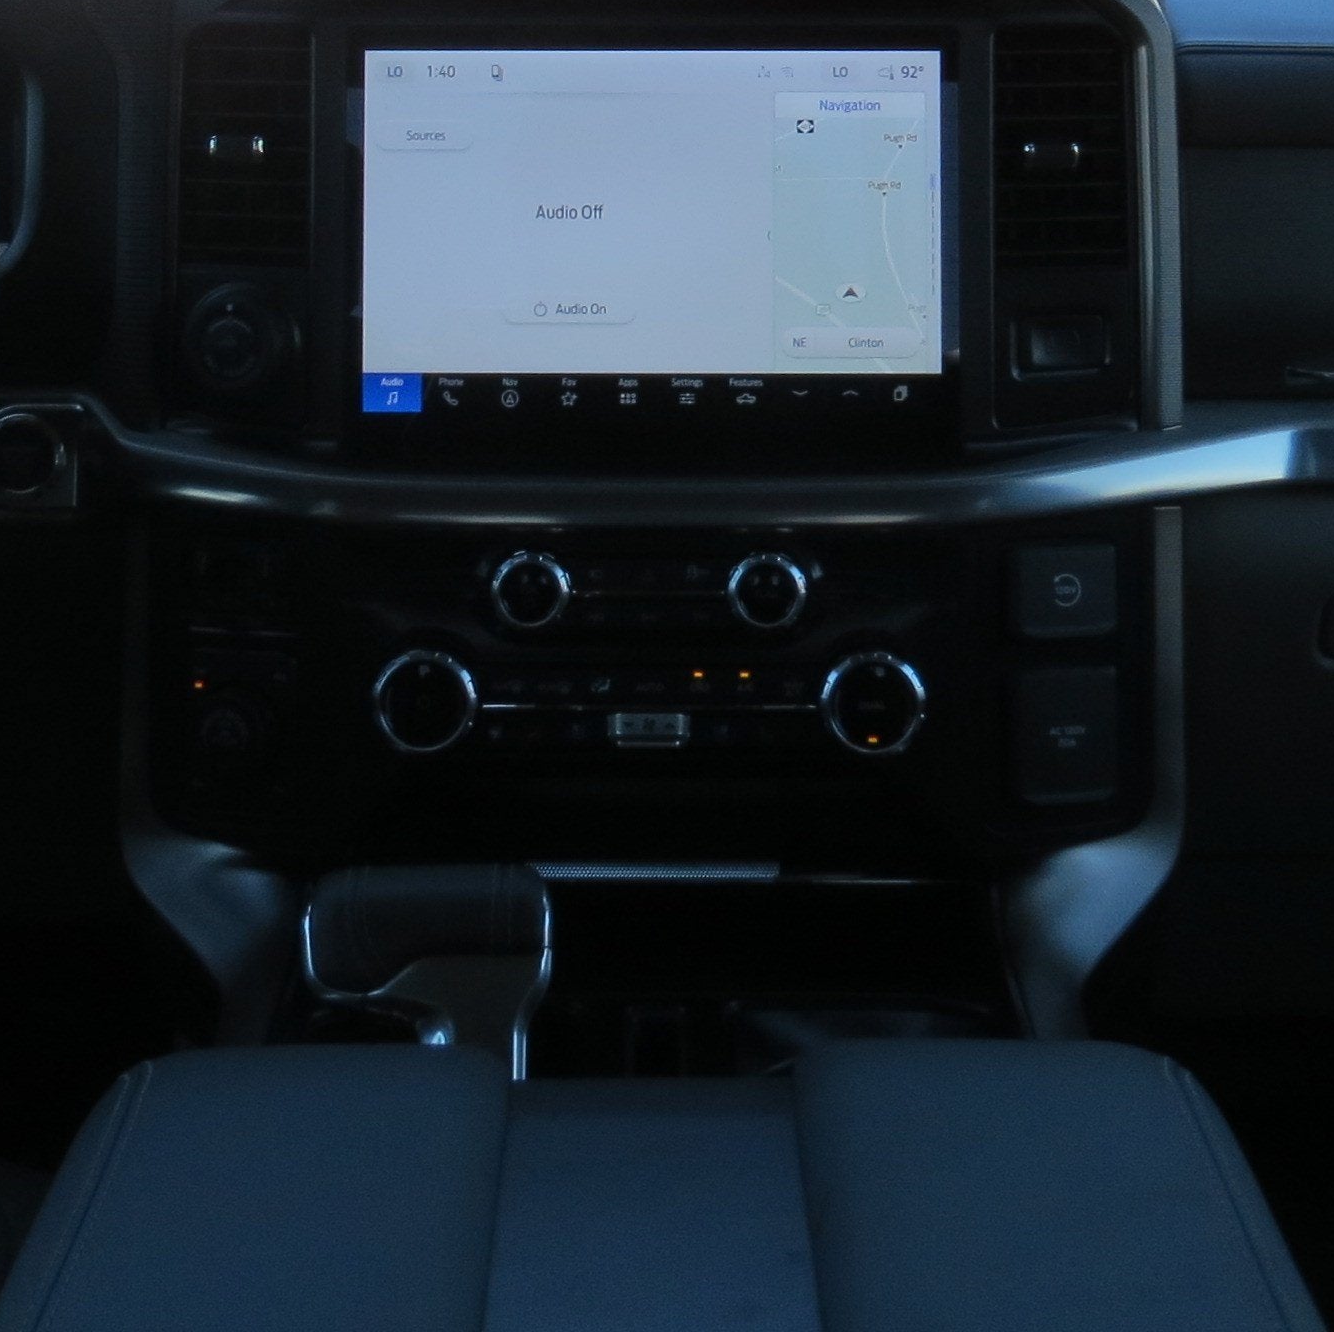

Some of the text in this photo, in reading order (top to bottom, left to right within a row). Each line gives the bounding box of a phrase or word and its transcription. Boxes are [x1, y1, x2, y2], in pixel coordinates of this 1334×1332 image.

[387, 65, 456, 78] LO 1:40
[832, 66, 848, 78] LO
[901, 65, 924, 79] 92°
[819, 100, 881, 113] Navigation
[406, 130, 446, 141] Sources
[535, 204, 604, 220] Audio Off
[555, 303, 607, 314] Audio On
[792, 337, 884, 348] NE Clinton
[380, 377, 404, 387] Audio
[438, 377, 464, 387] Phone
[502, 377, 519, 387] Nav
[561, 377, 577, 387] Fav
[618, 377, 639, 388] Apps
[671, 377, 704, 388] Settings
[729, 377, 764, 387] Features
